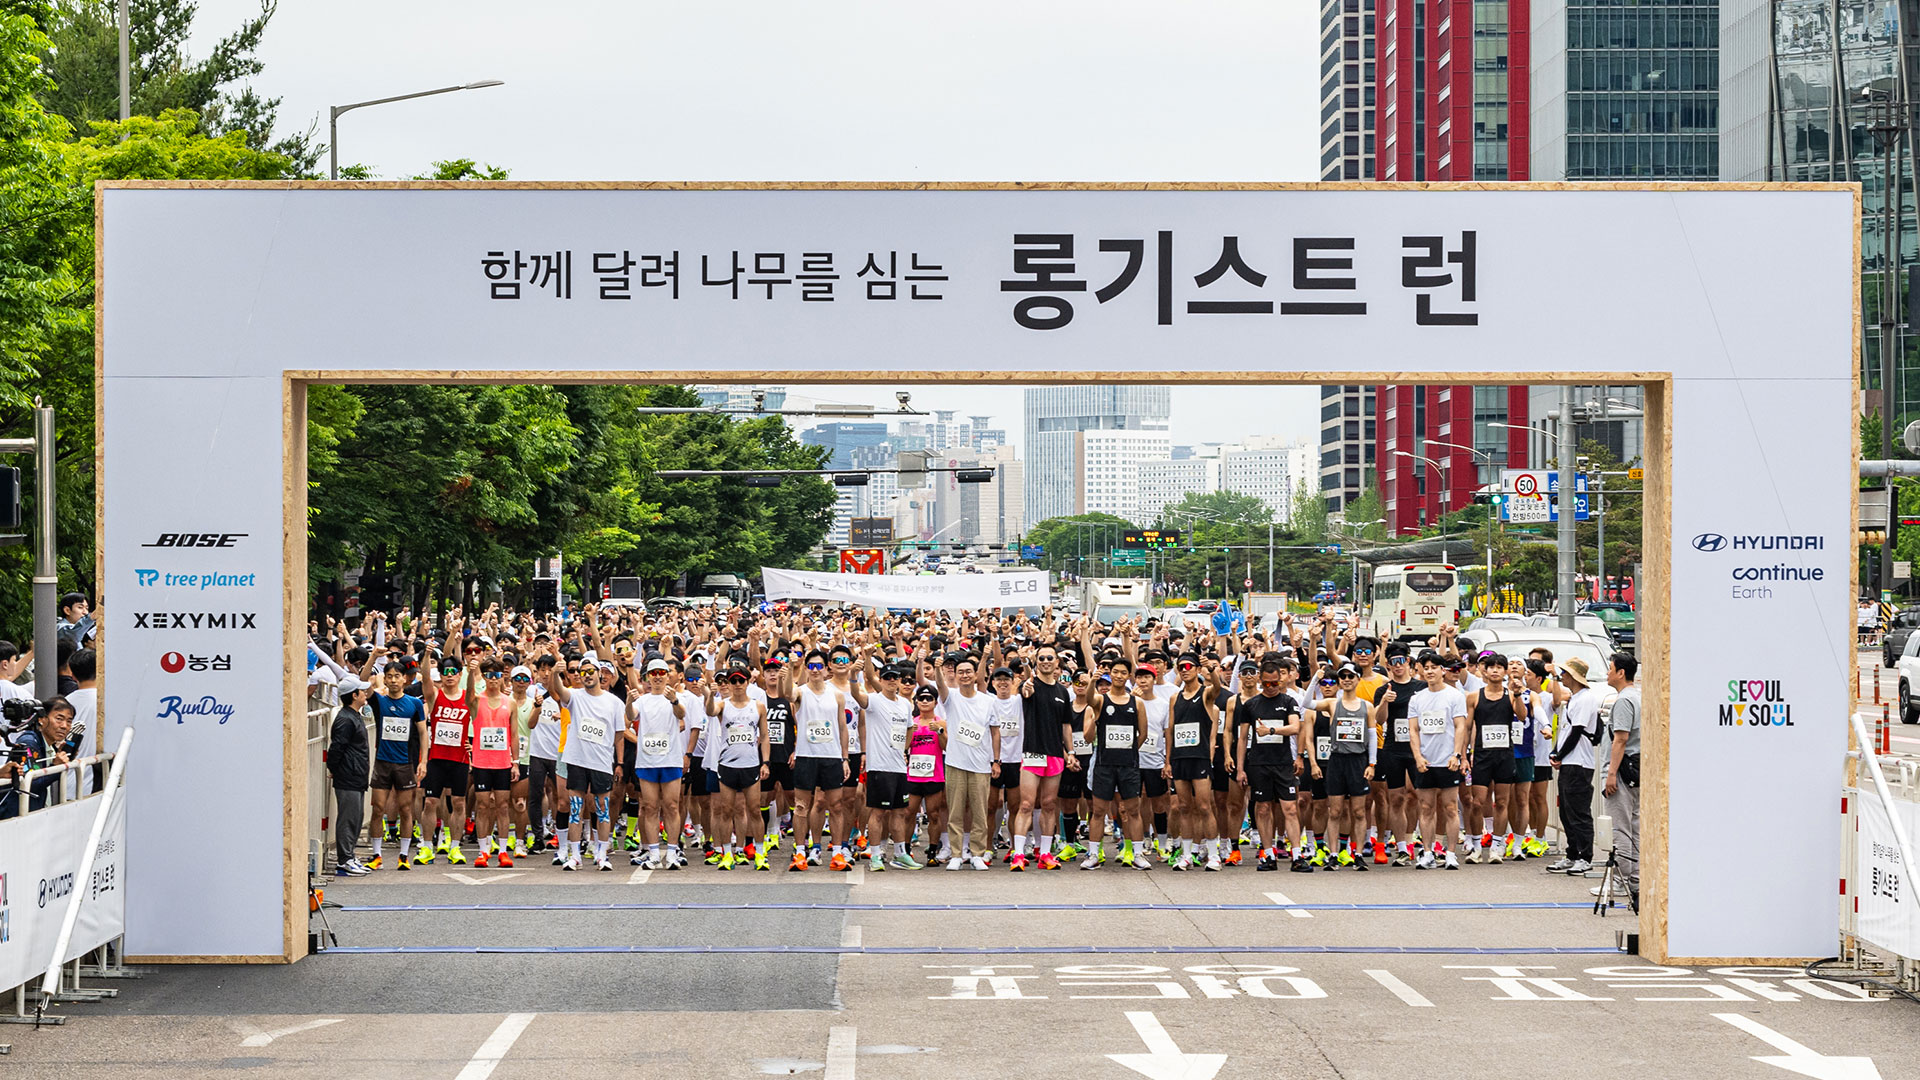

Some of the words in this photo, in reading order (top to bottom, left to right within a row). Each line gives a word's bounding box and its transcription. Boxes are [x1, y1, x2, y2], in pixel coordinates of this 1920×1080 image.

[481, 250, 571, 300] 함께
[592, 250, 680, 300] 달려
[701, 250, 840, 302] 나무를
[856, 250, 949, 300] 심는
[1000, 230, 1367, 330] 롱기스트
[1402, 230, 1479, 326] 런
[1519, 480, 1533, 492] 50
[149, 533, 242, 548] BOSE
[1733, 536, 1824, 550] HYUNDAI
[1733, 563, 1824, 581] continue
[165, 571, 198, 587] tree
[201, 571, 256, 591] planet
[1733, 586, 1772, 599] Earth
[133, 612, 257, 629] XEXYMIX
[188, 653, 232, 671] 농심
[1728, 680, 1785, 702] SEOUL
[156, 695, 235, 725] RunDay
[435, 706, 468, 720] 1987
[1749, 704, 1795, 726] SOUL
[1423, 718, 1444, 726] 0306
[385, 725, 408, 734] 0462
[437, 729, 460, 739] 0436
[582, 724, 604, 737] 0008
[810, 728, 831, 736] 1630
[958, 726, 981, 741] 3000
[1176, 730, 1197, 739] 0623
[483, 735, 505, 743] 1124
[644, 739, 668, 748] 0346
[730, 734, 752, 743] 0702
[892, 733, 906, 743] 059
[1108, 733, 1131, 741] 0358
[1485, 733, 1507, 741] 1397
